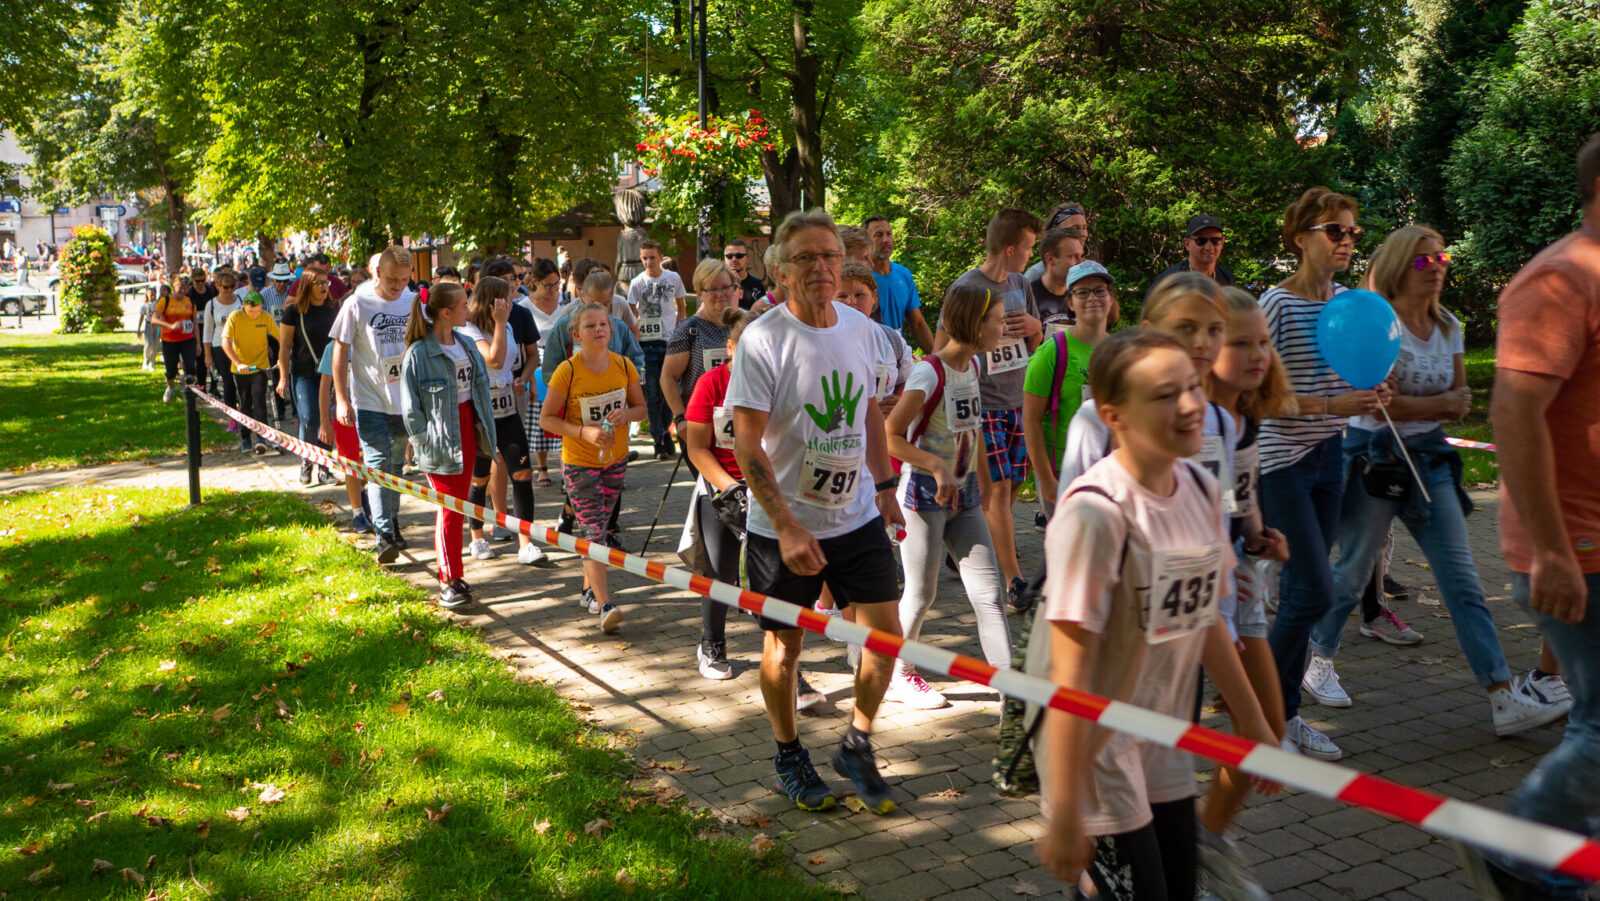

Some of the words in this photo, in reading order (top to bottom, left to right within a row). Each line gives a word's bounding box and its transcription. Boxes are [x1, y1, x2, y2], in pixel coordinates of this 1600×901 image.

[640, 323, 660, 334] 469
[992, 343, 1023, 364] 661
[492, 394, 512, 410] 401
[1161, 570, 1217, 618] 435
